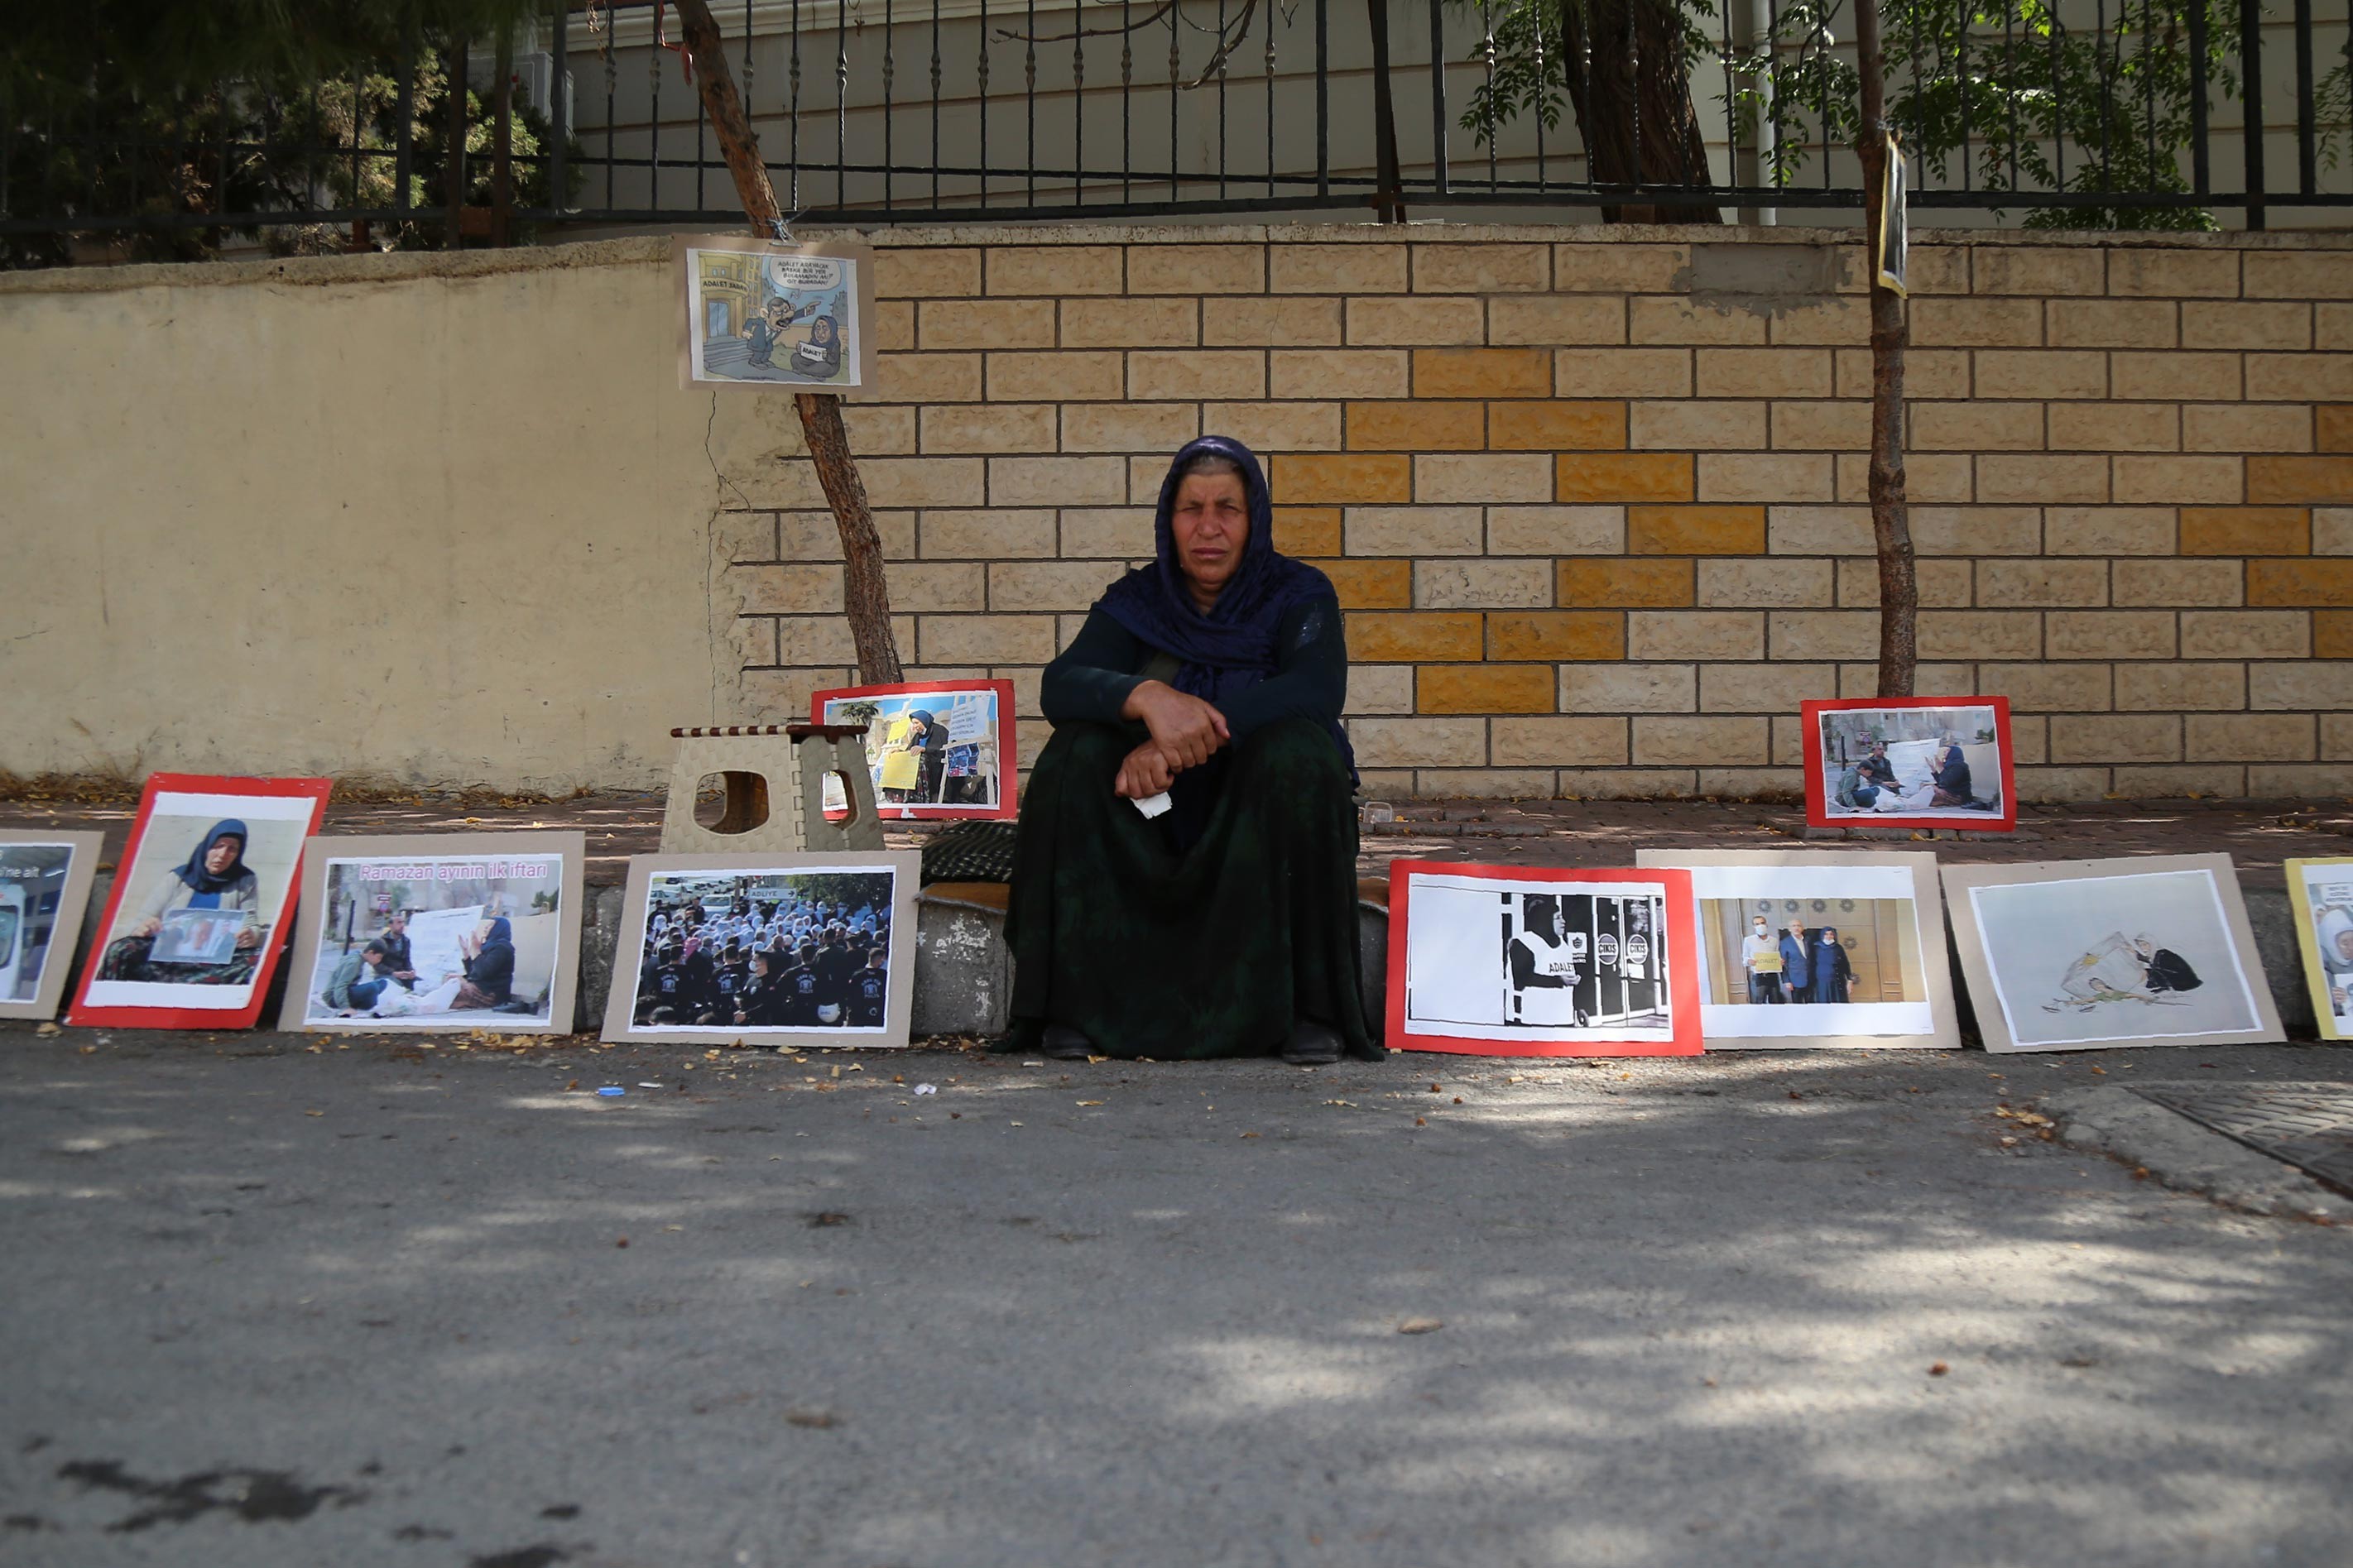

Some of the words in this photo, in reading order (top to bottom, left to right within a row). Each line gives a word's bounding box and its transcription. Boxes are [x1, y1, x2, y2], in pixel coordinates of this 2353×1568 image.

[803, 347, 821, 357] ADALET
[360, 865, 433, 880] Ramazan
[437, 866, 483, 884] ayının
[487, 862, 507, 880] ilk
[509, 862, 547, 879] iftarı
